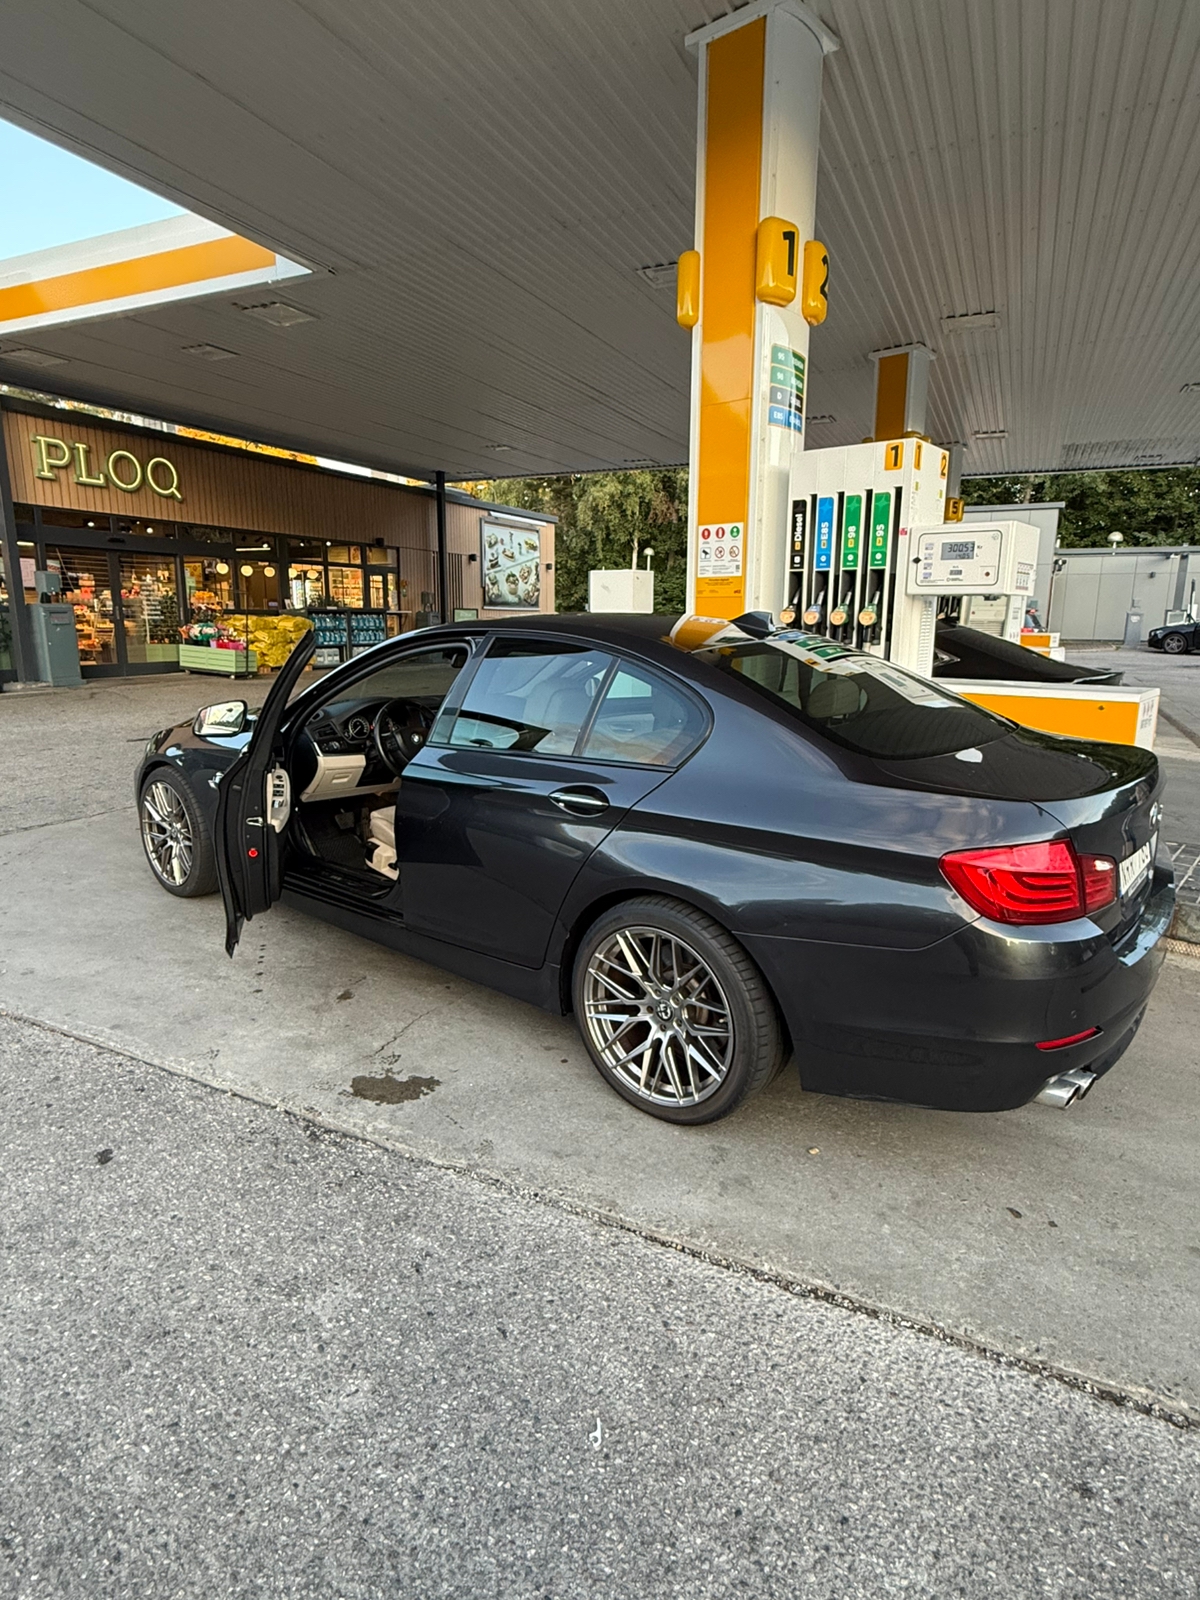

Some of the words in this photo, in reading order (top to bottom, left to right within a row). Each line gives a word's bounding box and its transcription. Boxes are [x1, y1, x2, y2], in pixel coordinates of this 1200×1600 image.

[782, 230, 796, 277] 1
[820, 254, 830, 301] 2
[32, 433, 183, 502] PLOQ
[890, 444, 900, 468] 1
[917, 444, 922, 468] 1
[940, 454, 947, 477] 2
[951, 501, 959, 515] 5
[794, 513, 803, 542] Diesel
[820, 521, 829, 540] E85
[847, 525, 857, 539] 98
[875, 523, 885, 537] 95
